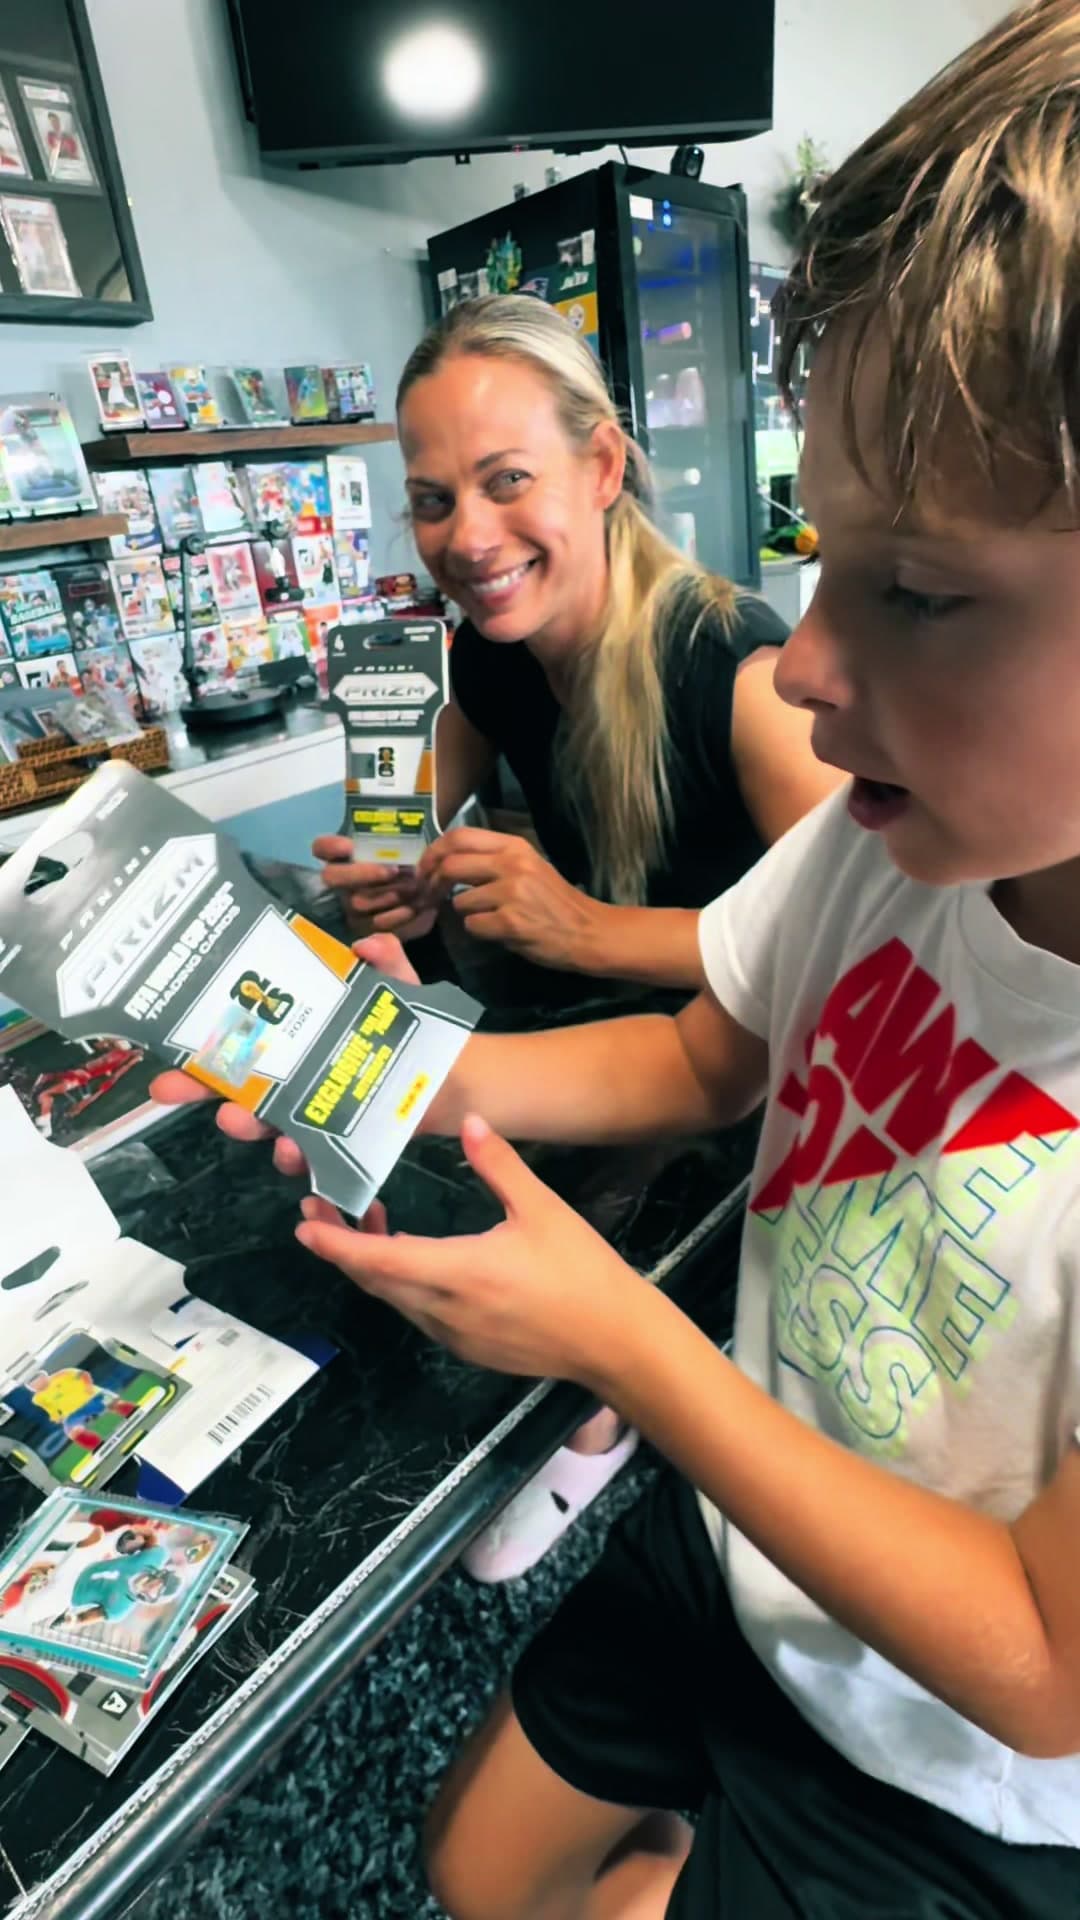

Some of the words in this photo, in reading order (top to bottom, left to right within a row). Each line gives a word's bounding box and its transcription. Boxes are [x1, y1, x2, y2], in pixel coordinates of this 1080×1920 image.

[345, 683, 425, 698] PRIZM
[60, 846, 151, 950] PANINI
[82, 852, 205, 999] PRIZM
[147, 954, 203, 1019] TRADING
[198, 906, 240, 954] CARDS
[287, 1006, 313, 1039] 2026
[304, 1034, 374, 1124] EXCLUSIVE
